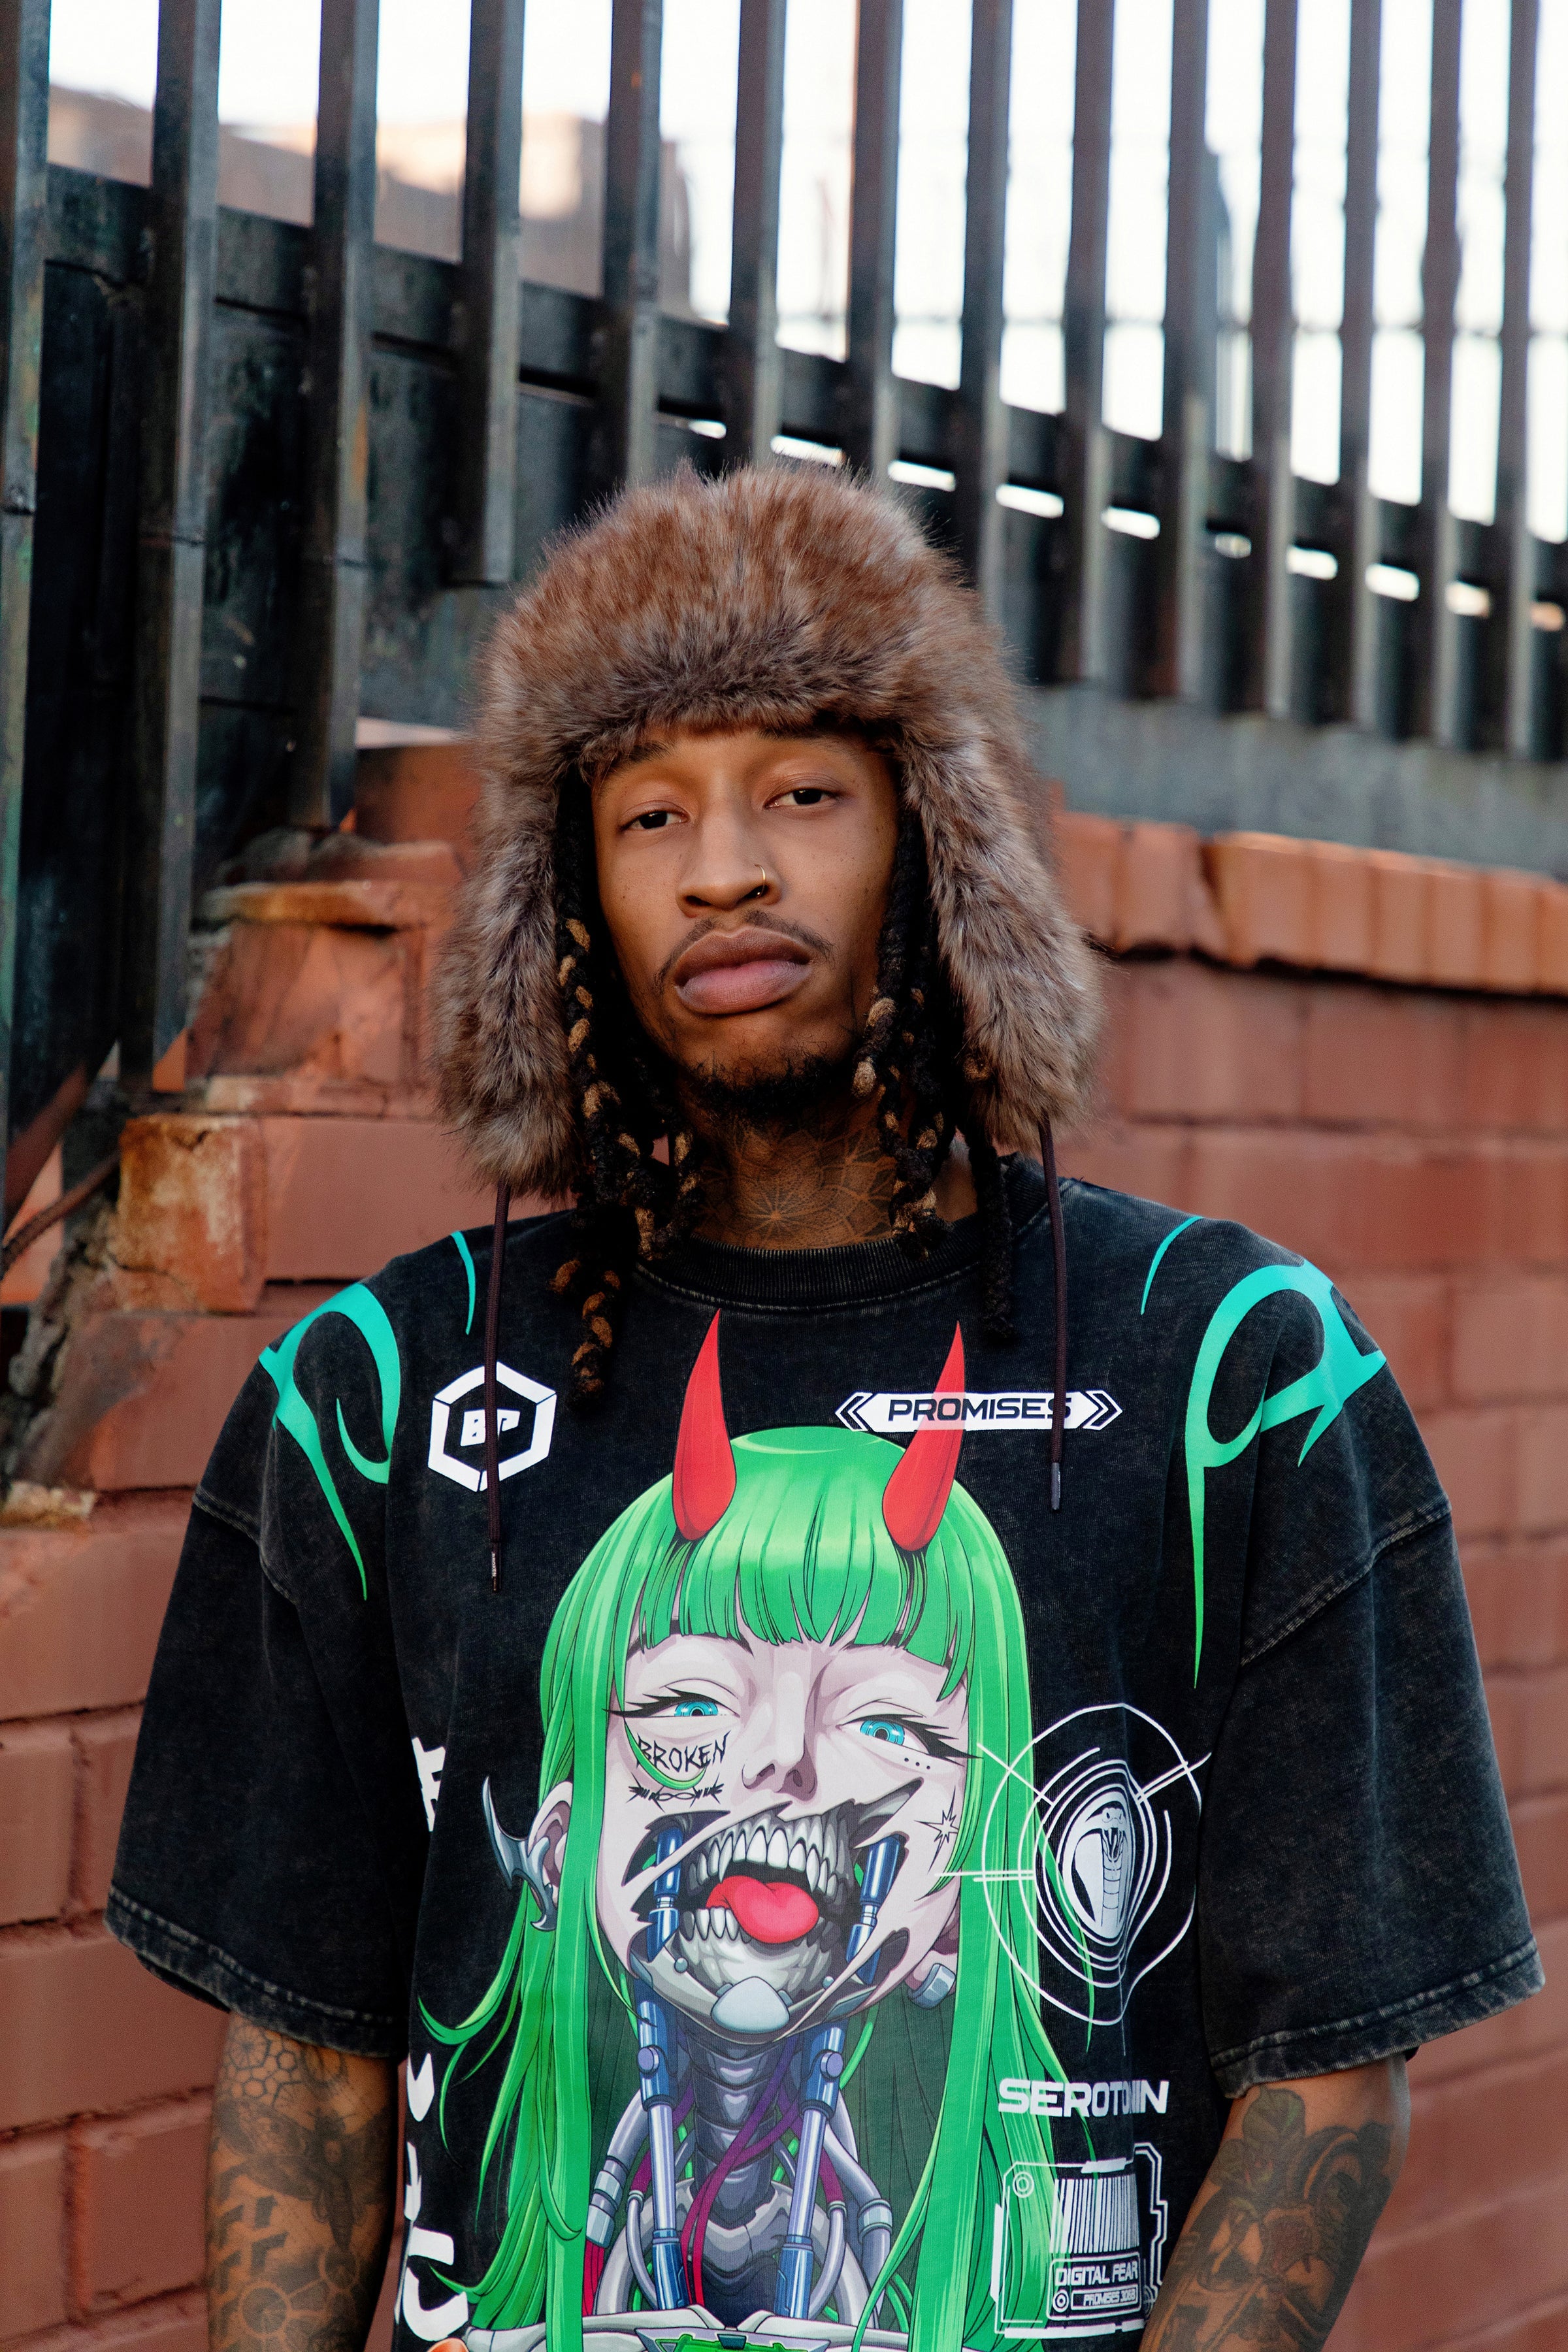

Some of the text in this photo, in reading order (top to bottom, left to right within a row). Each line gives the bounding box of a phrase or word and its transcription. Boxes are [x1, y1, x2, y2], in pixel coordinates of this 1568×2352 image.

[636, 1730, 731, 1772] BROKEN
[1054, 2261, 1138, 2286] DIGITAL FEAR
